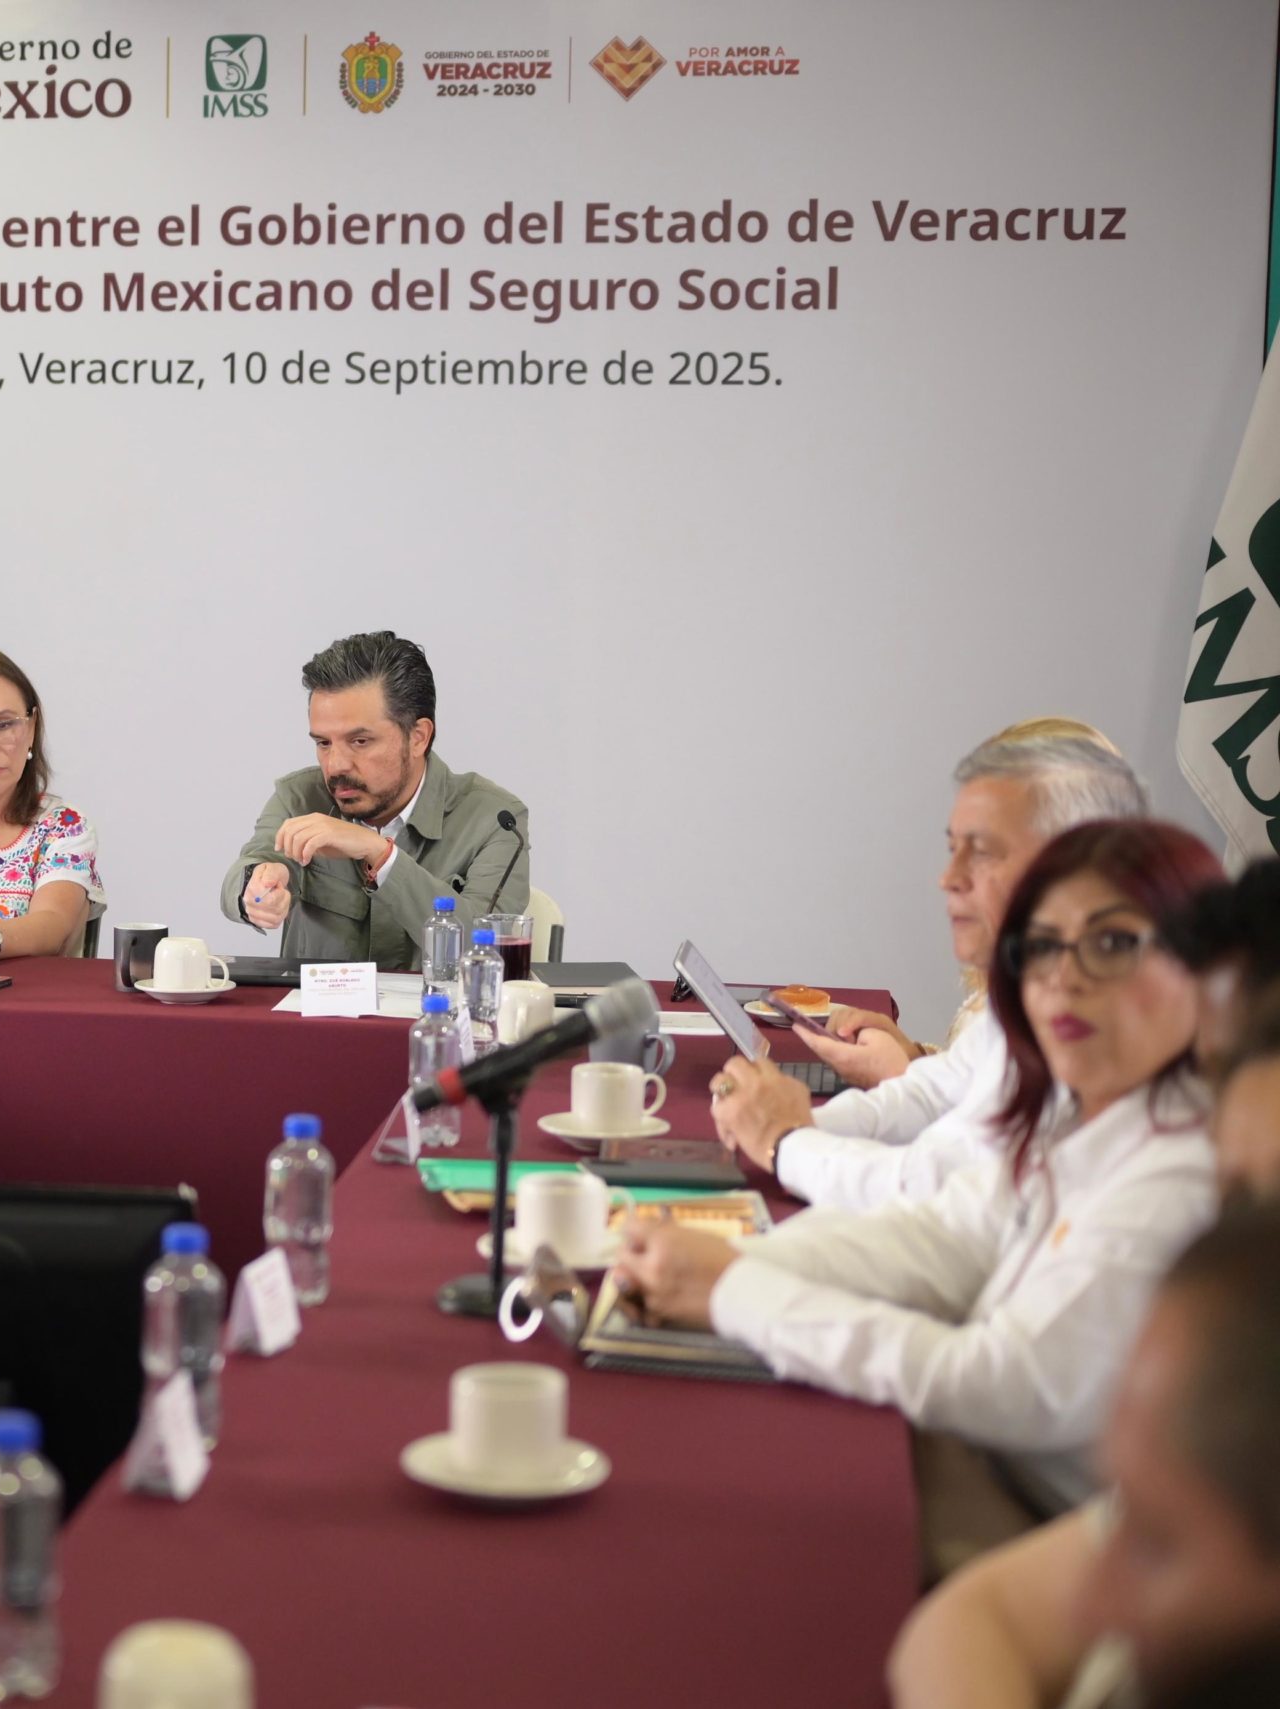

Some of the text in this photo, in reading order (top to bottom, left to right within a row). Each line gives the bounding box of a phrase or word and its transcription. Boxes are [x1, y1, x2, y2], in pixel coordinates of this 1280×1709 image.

[93, 30, 133, 60] de
[424, 49, 550, 60] GOBIERNO DEL ESTADO DE
[688, 46, 786, 59] POR AMOR A
[422, 61, 552, 81] VERACRUZ
[675, 59, 801, 77] VERACRUZ
[436, 84, 480, 97] 2024
[493, 83, 536, 97] 2030
[203, 94, 269, 119] IMSS
[1, 210, 141, 249] entre
[157, 203, 201, 248] el
[219, 201, 466, 247] Gobierno
[483, 200, 564, 246] del
[585, 199, 769, 245] Estado
[787, 197, 855, 244] de
[872, 199, 1127, 243] Veracruz
[102, 268, 354, 313] Mexicano
[370, 267, 450, 312] del
[468, 269, 660, 325] Seguro
[677, 267, 839, 312] Social
[18, 351, 205, 391] Veracruz,
[222, 350, 268, 385] 10
[281, 349, 331, 385] de
[344, 349, 588, 396] Septiembre
[602, 349, 654, 386] de
[668, 351, 783, 387] 2025.
